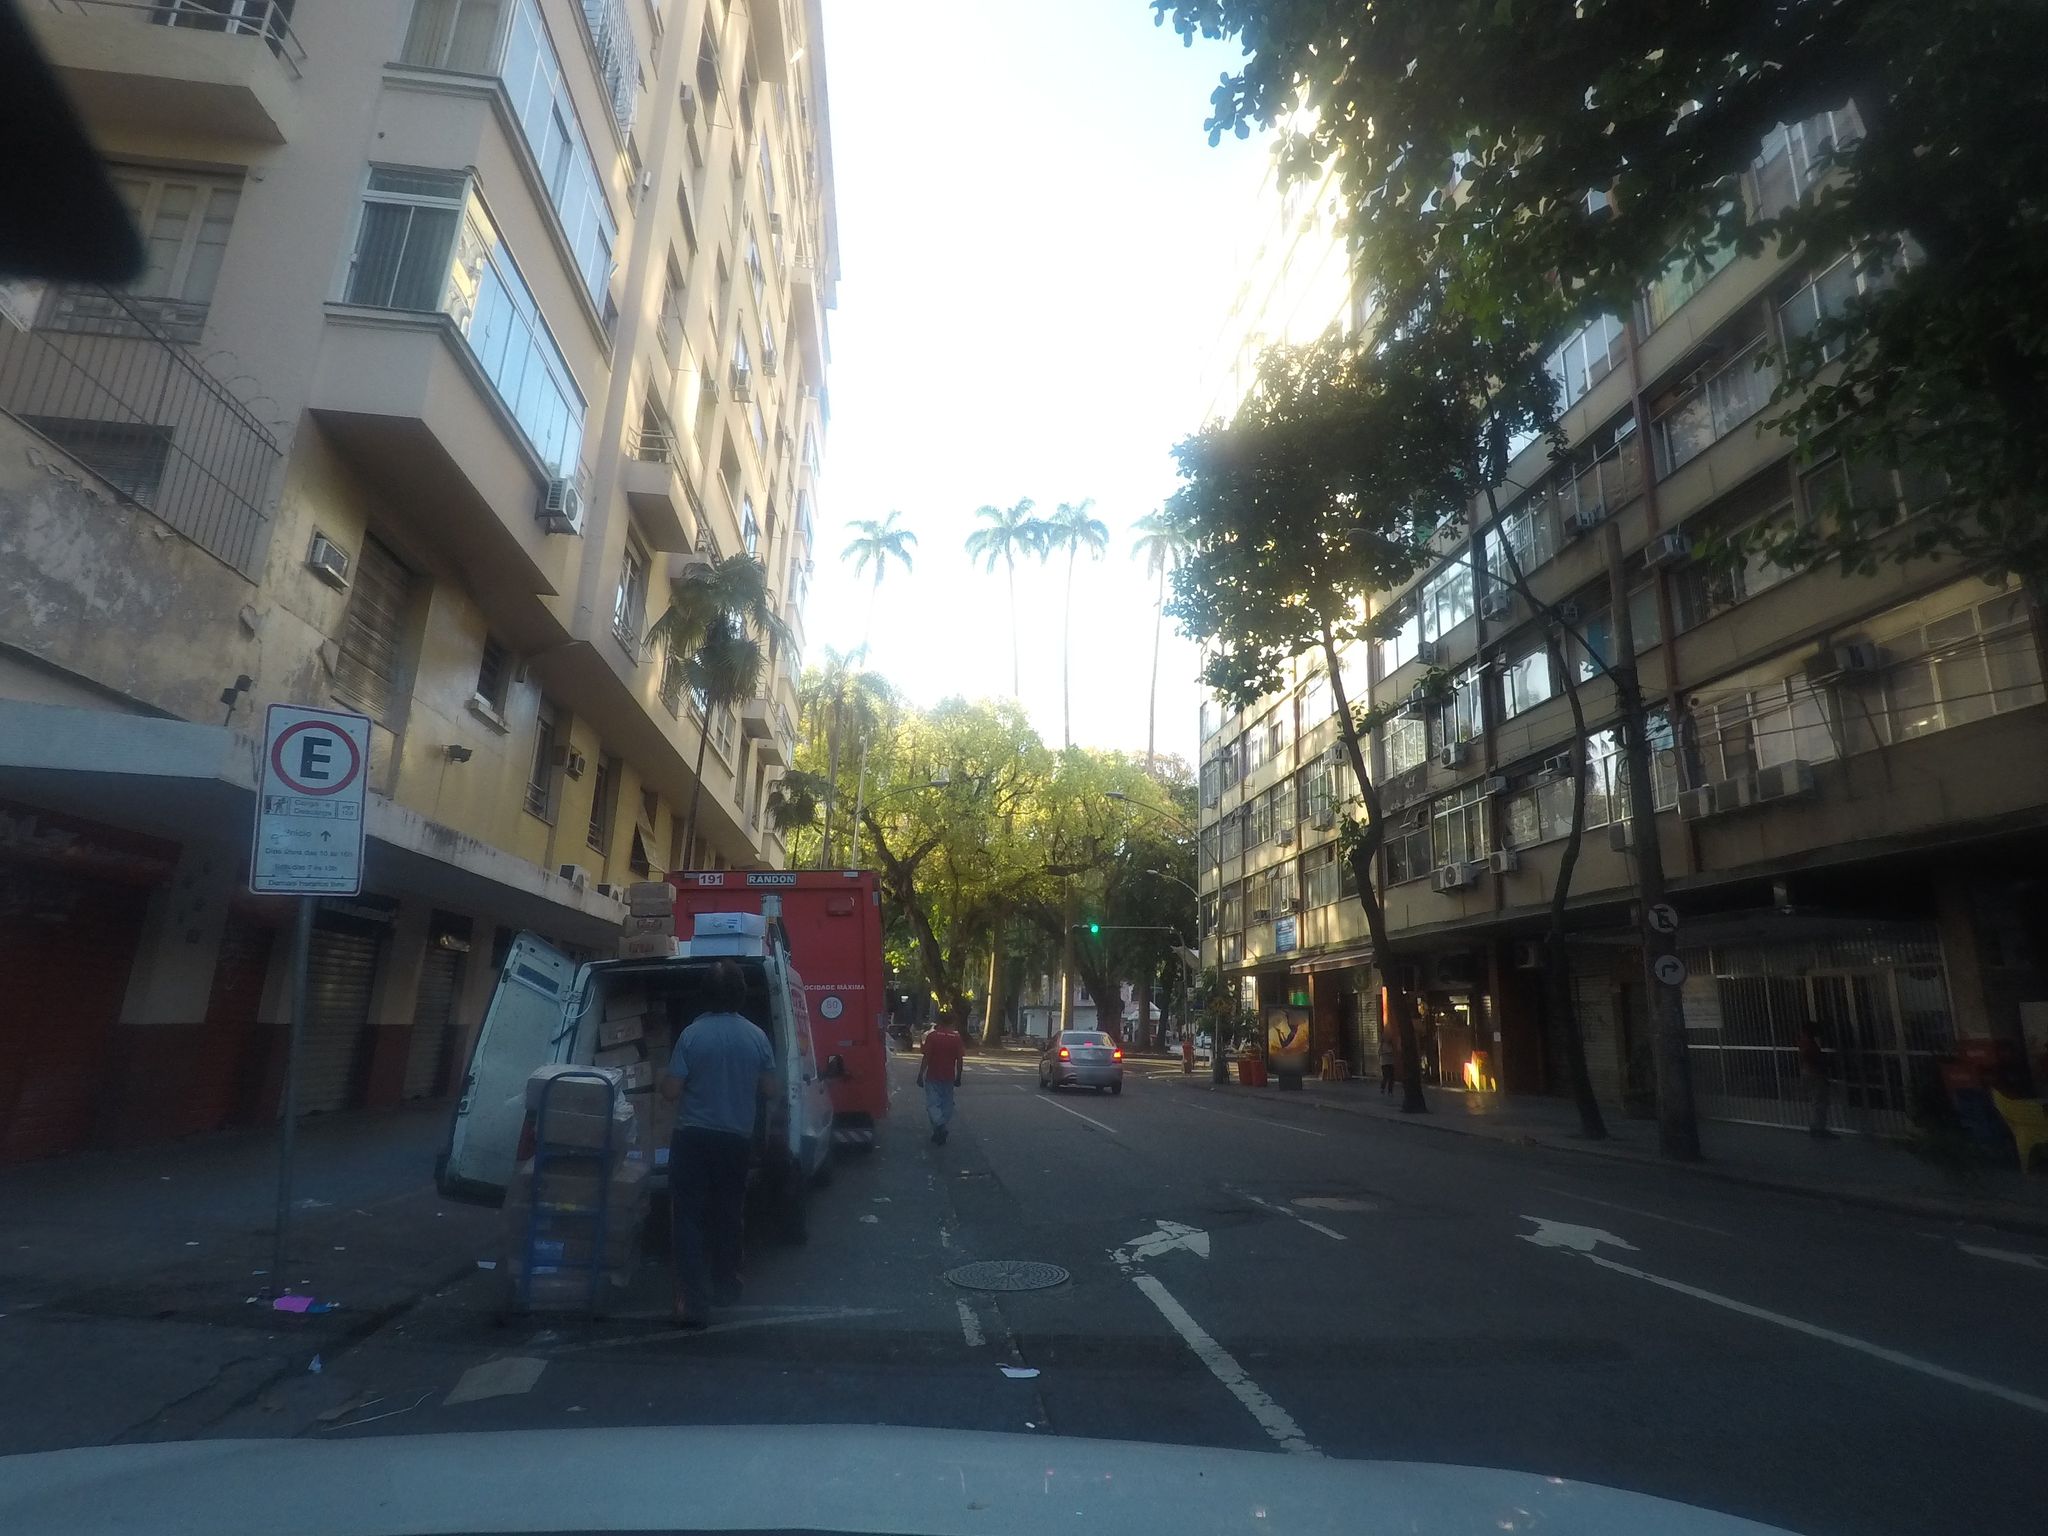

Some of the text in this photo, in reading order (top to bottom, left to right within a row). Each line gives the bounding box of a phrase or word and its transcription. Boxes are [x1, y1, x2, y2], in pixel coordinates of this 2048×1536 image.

[300, 735, 333, 780] E
[700, 874, 723, 884] 191
[749, 875, 795, 884] RANDON
